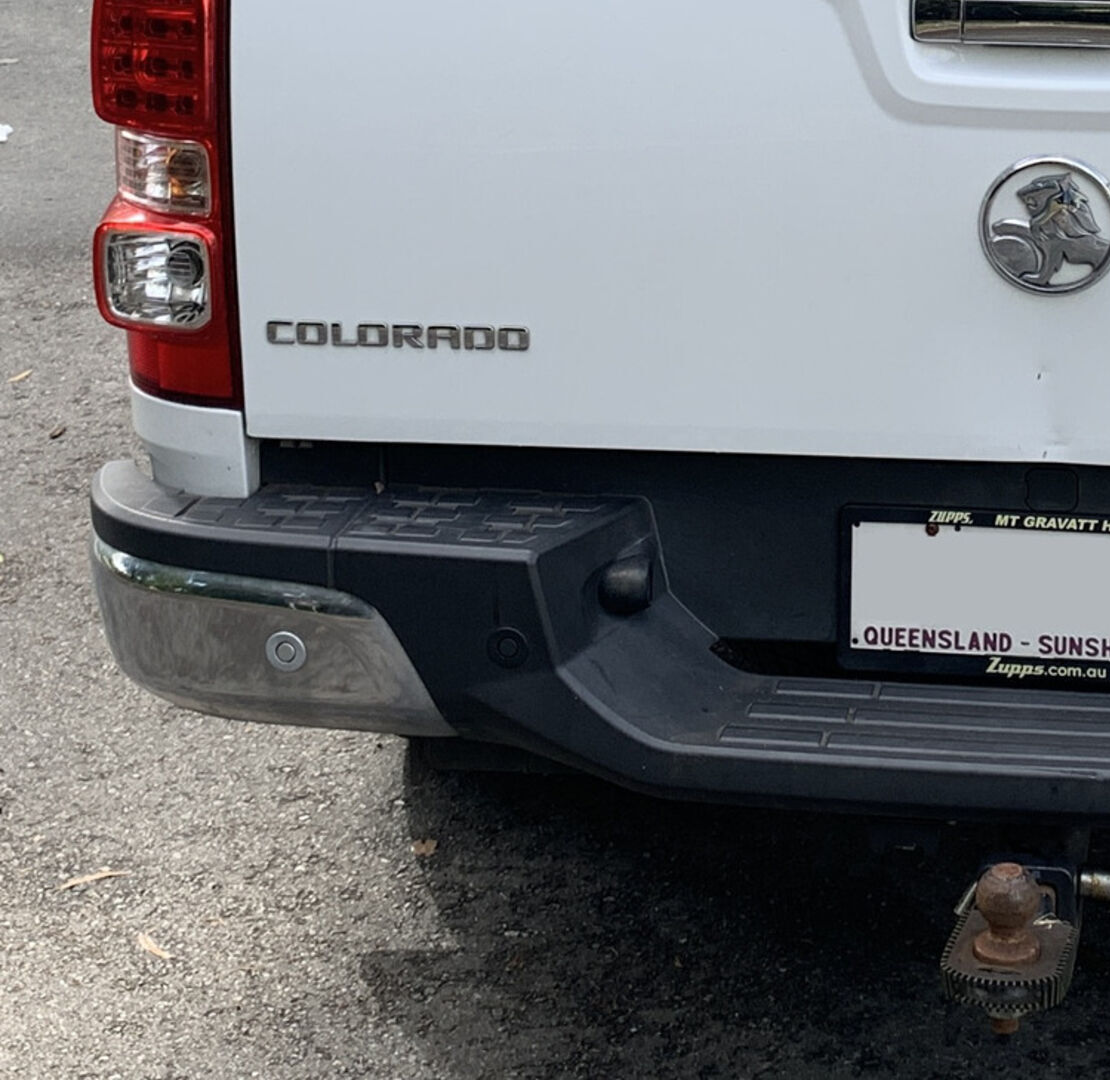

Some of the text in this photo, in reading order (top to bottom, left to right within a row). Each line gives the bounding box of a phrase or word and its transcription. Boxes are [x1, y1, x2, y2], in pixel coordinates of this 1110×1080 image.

[266, 320, 530, 351] COLORADO
[995, 514, 1019, 527] MT
[1023, 516, 1098, 532] GRAVATT
[863, 626, 1012, 653] QUEENSLAND
[986, 656, 1107, 679] Zupps.com.au
